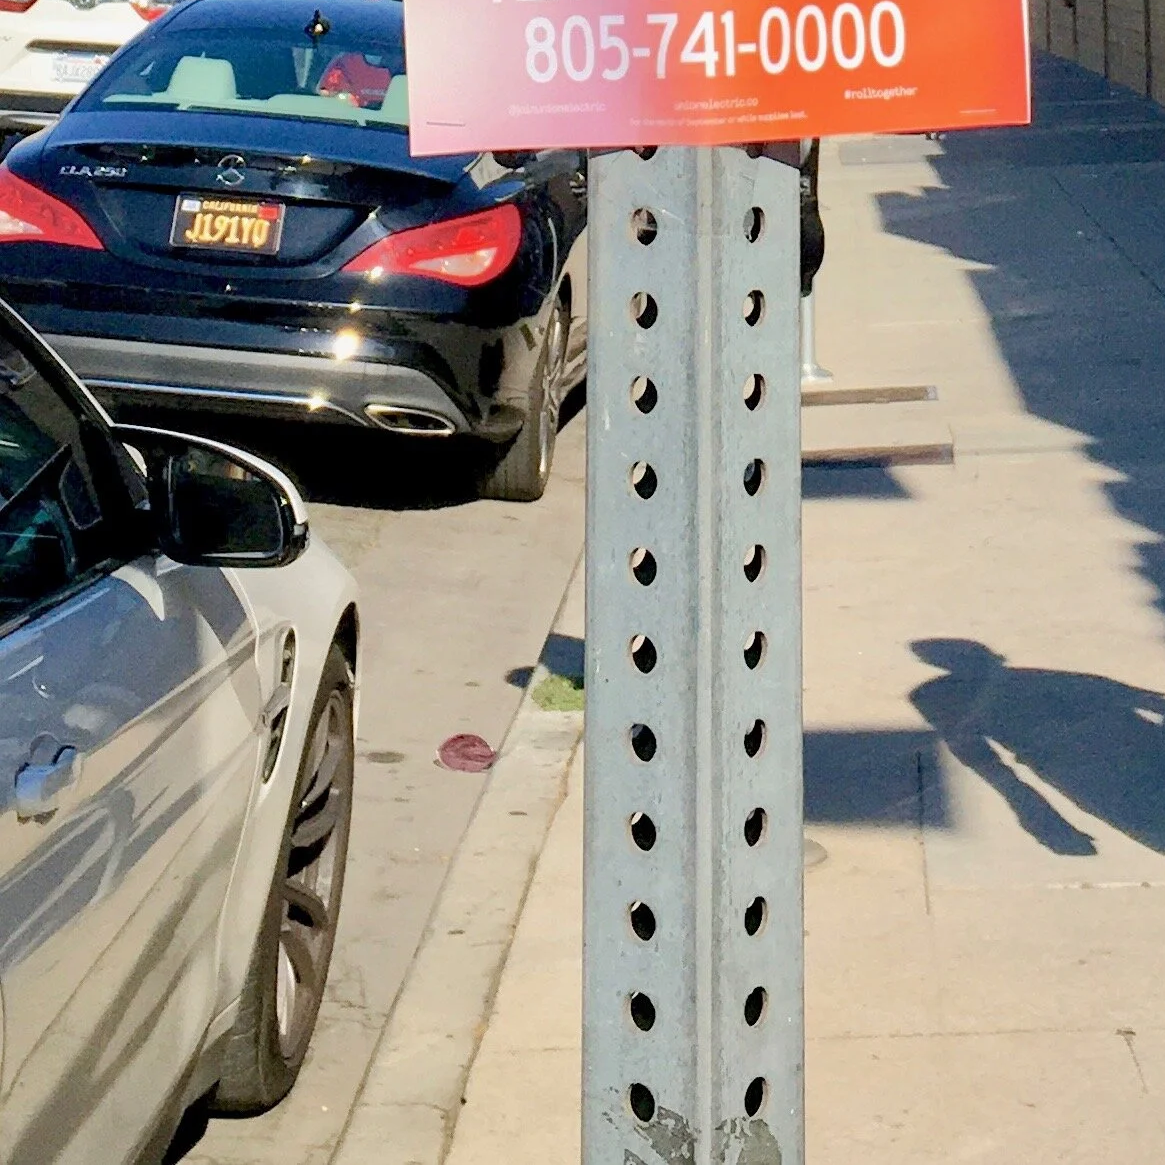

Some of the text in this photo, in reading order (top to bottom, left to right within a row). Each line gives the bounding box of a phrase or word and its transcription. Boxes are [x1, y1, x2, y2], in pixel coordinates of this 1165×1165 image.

[525, 1, 906, 83] 805-741-0000
[844, 86, 918, 100] #rolltogether
[202, 200, 258, 214] CALIFORNIA
